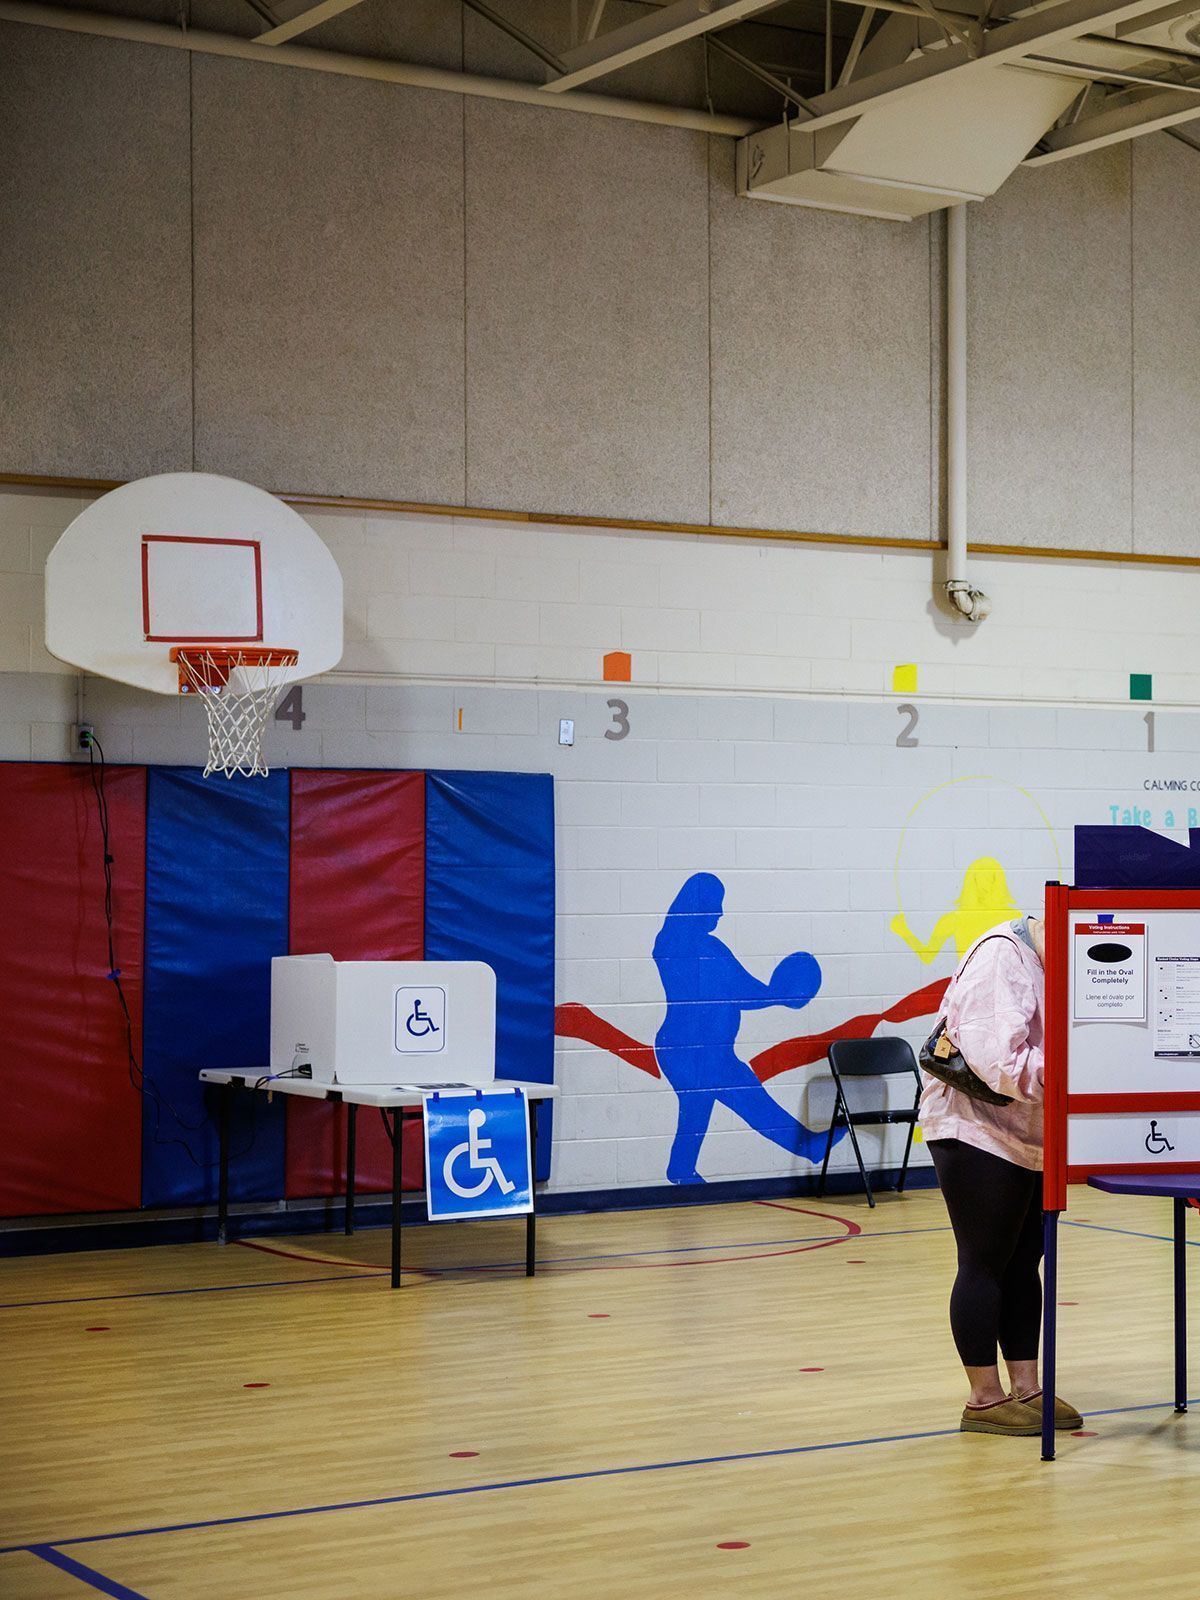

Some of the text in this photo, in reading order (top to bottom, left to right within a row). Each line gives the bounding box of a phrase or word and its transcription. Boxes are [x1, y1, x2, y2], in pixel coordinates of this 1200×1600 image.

[275, 685, 306, 731] 4
[604, 698, 631, 740] 3
[896, 703, 919, 748] 2
[1143, 711, 1154, 752] 1
[1143, 779, 1188, 791] CALMING
[1109, 805, 1152, 827] Take
[1164, 810, 1175, 828] a
